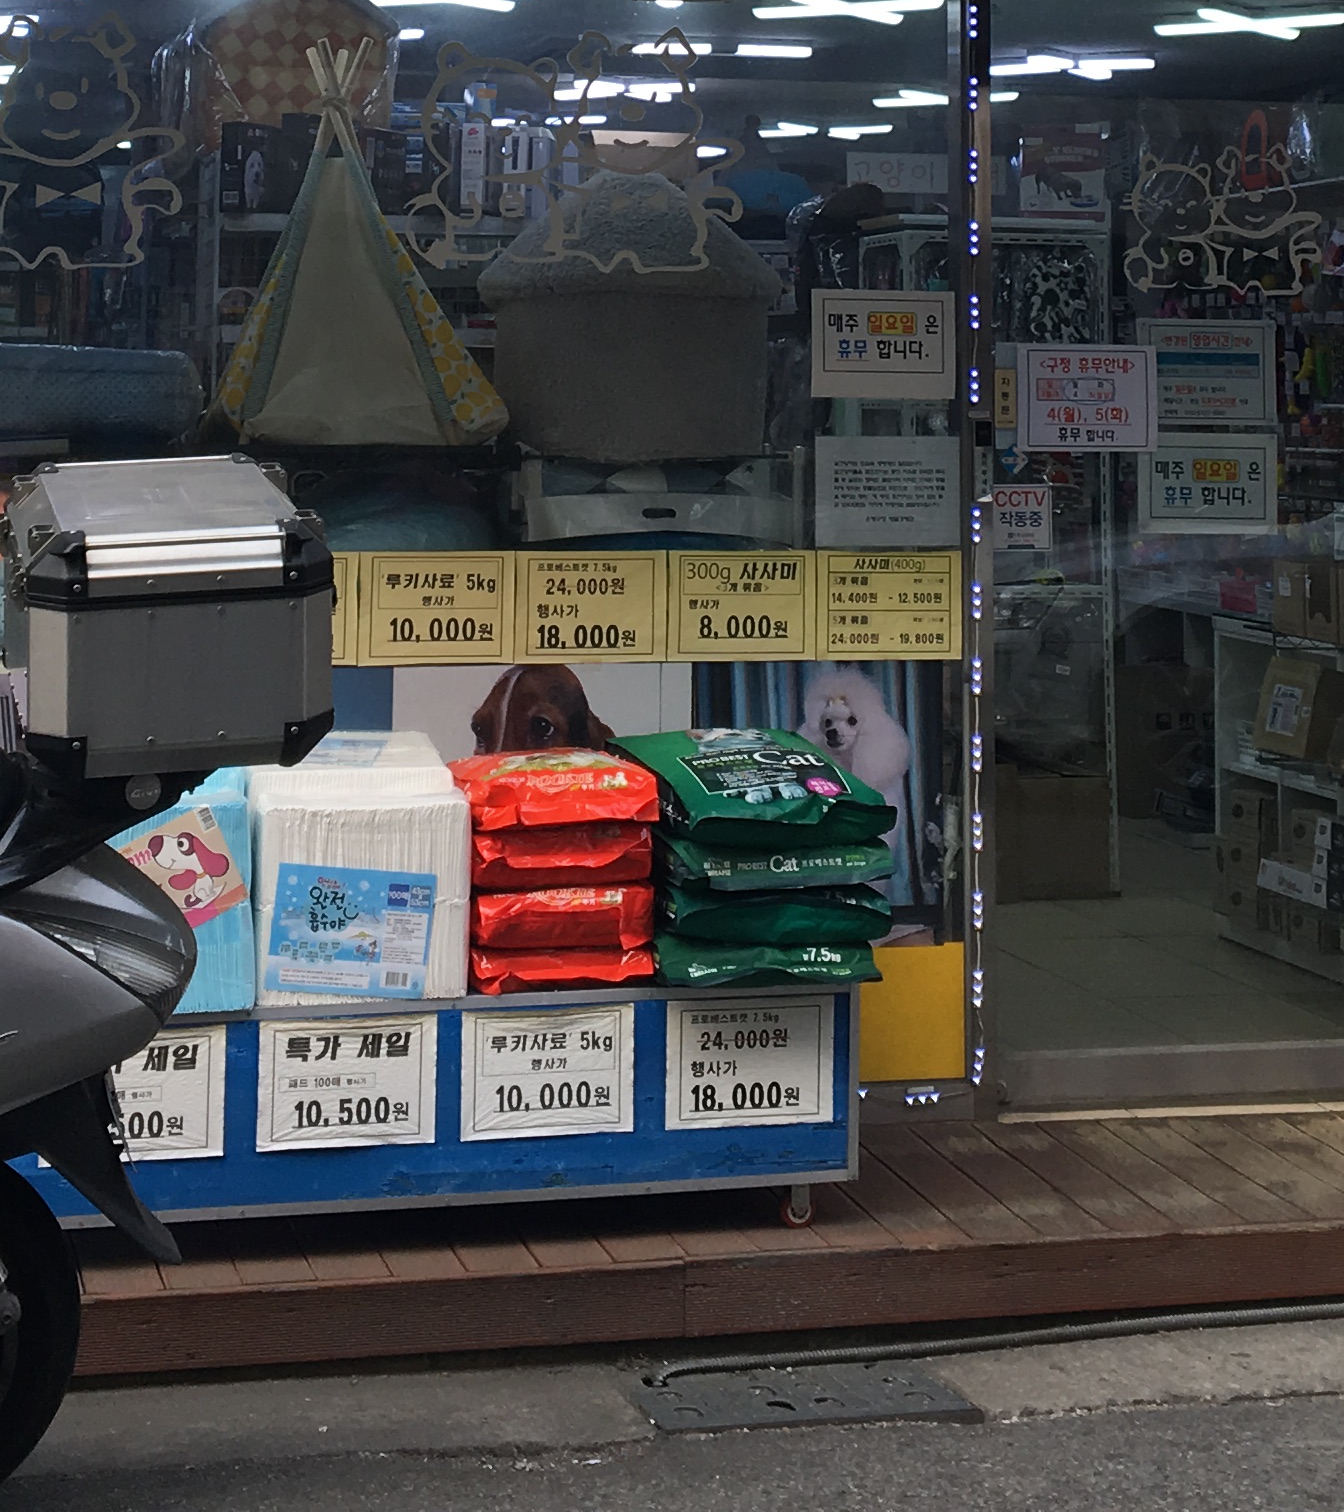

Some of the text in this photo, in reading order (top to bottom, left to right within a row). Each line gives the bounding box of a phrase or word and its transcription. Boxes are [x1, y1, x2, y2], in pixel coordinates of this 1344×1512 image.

[828, 313, 939, 335] 매주 일요일 은
[838, 339, 929, 360] 휴무 합니다.
[1040, 357, 1136, 374] <구정 휴무안내>
[1047, 406, 1129, 424] 4(월), 5(화)
[1058, 427, 1118, 442] 휴무 합니다.
[1155, 460, 1261, 481] 매주 일요일 은
[994, 490, 1047, 508] CCTV
[1164, 486, 1252, 506] 휴무 합니다.
[999, 510, 1043, 529] 작동중
[593, 562, 618, 574] 7.5kg
[686, 562, 797, 585] 300g 사사미
[853, 558, 926, 573] 사사미(400g)
[466, 573, 497, 593] 5kg
[545, 577, 625, 596] 24,000원
[422, 595, 455, 607] 행사가
[536, 603, 579, 619] 행사가
[688, 599, 720, 610] 행사가
[389, 617, 494, 643] 10,000원
[536, 624, 636, 649] 18,000원
[699, 614, 788, 640] 8,000원
[752, 750, 825, 767] Cat
[770, 855, 800, 873] Cat
[309, 885, 347, 912] 완전
[308, 908, 348, 933] 흡수야
[753, 1012, 781, 1024] 7.5kg
[285, 1031, 412, 1063] 특가 세일
[580, 1030, 613, 1052] 5kg
[699, 1028, 789, 1051] 24,000원
[142, 1044, 199, 1072] 세일
[531, 1057, 568, 1072] 행사가
[690, 1059, 738, 1078] 행사가
[495, 1080, 611, 1113] 10,000원
[690, 1081, 801, 1113] 18,000원
[294, 1096, 409, 1128] 10,500원
[108, 1110, 184, 1138] 500원
